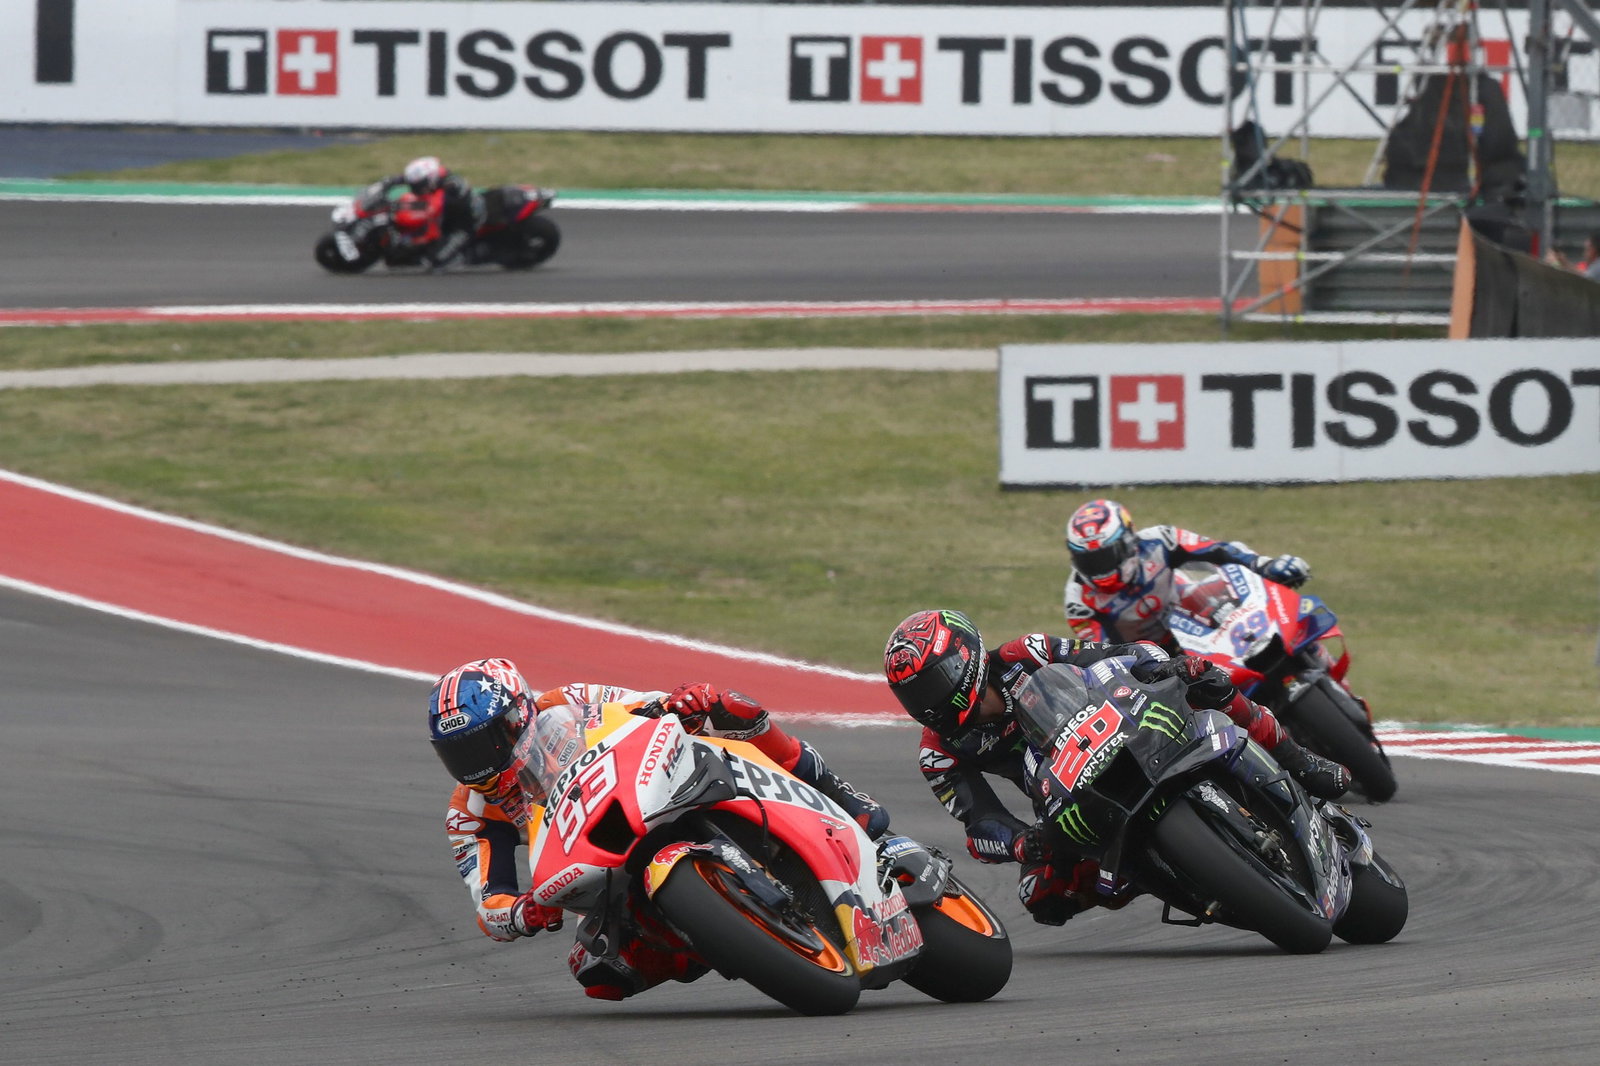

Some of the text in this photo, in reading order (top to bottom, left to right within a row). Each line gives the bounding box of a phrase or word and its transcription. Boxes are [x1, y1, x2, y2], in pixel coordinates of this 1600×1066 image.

[353, 29, 731, 101] TISSOT
[937, 35, 1317, 107] TISSOT
[1230, 610, 1270, 658] 89
[961, 649, 976, 691] MONSTER
[1001, 687, 1014, 713] YAMAHA
[440, 716, 466, 732] SHOEI
[1050, 699, 1124, 793] 20
[1054, 704, 1098, 748] ENEOS
[560, 741, 578, 765] SHOEI
[638, 722, 676, 787] HONDA
[660, 734, 684, 779] HRC
[1076, 731, 1129, 790] MONSTER
[543, 741, 611, 829] REPSOL
[554, 748, 620, 856] 93
[728, 752, 846, 822] EPSOL
[973, 838, 1010, 856] YAMAHA
[538, 867, 585, 901] HONDA
[879, 892, 909, 921] HONDA
[888, 923, 904, 959] Red
